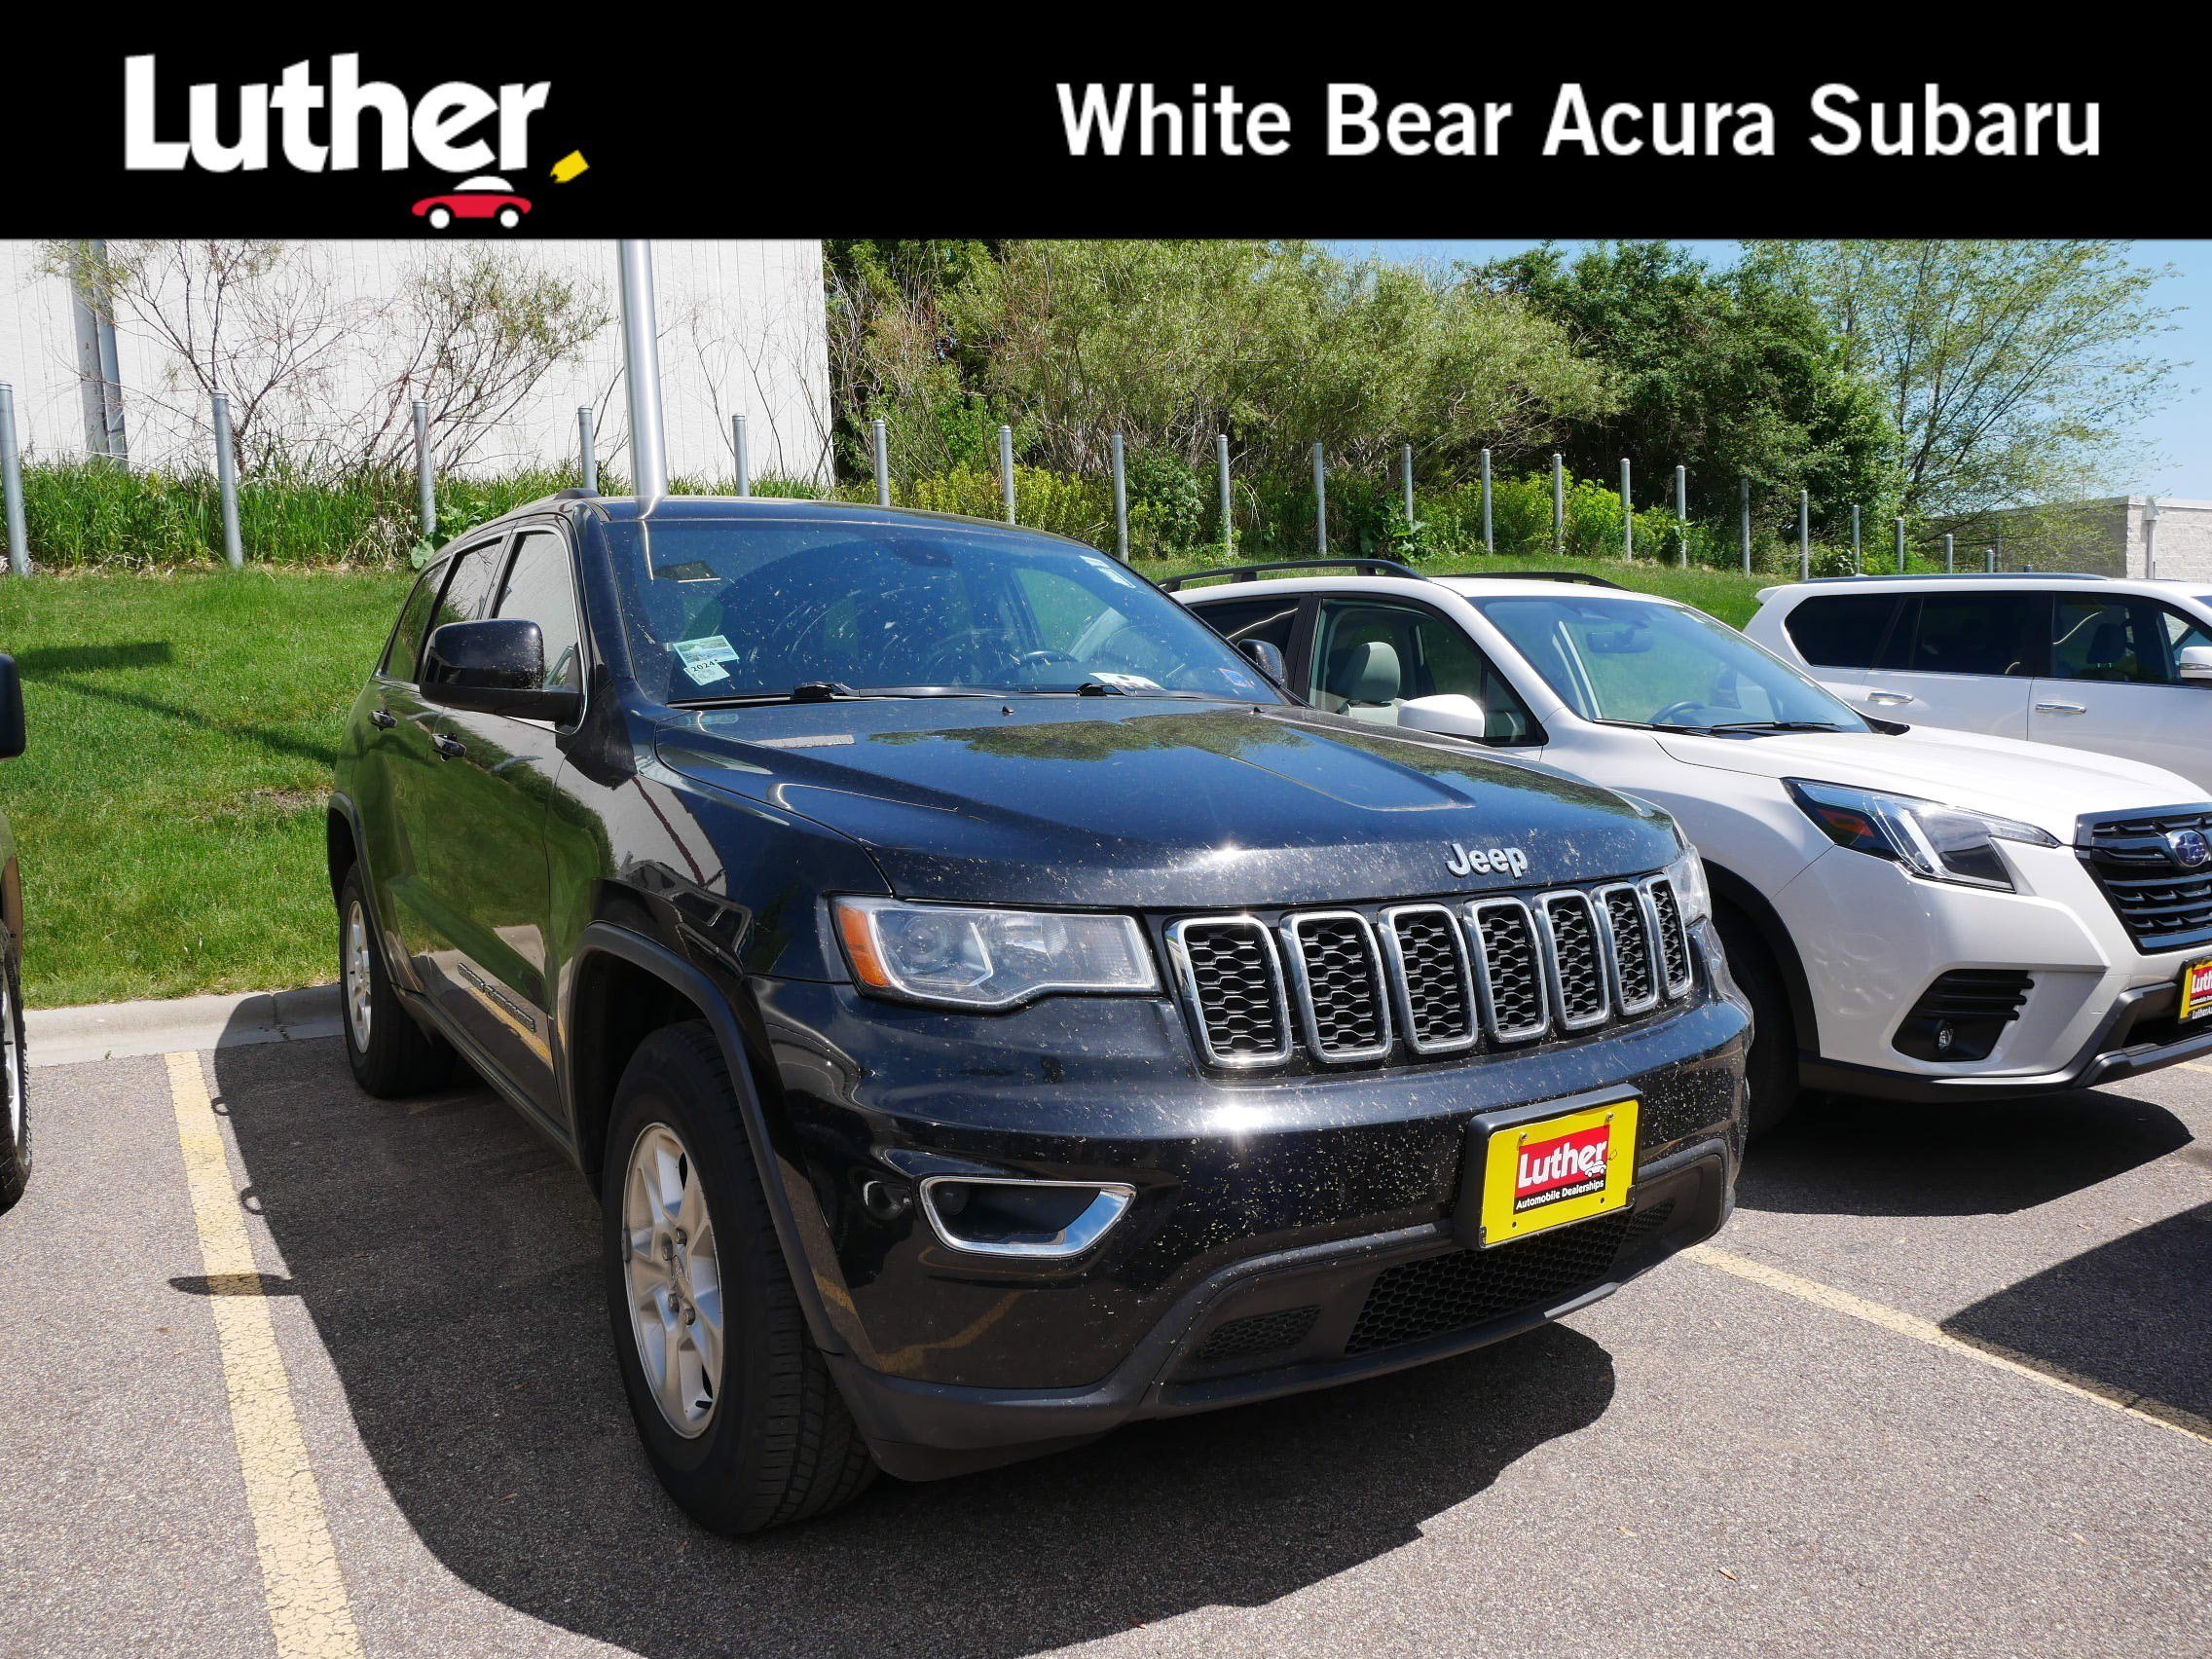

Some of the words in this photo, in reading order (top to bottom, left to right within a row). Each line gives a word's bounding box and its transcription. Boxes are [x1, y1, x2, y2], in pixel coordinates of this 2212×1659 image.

[1446, 843, 1529, 879] Jeep
[1518, 1141, 1607, 1189] Luther
[1515, 1190, 1561, 1210] Automobile
[1562, 1179, 1604, 1198] Dealerships
